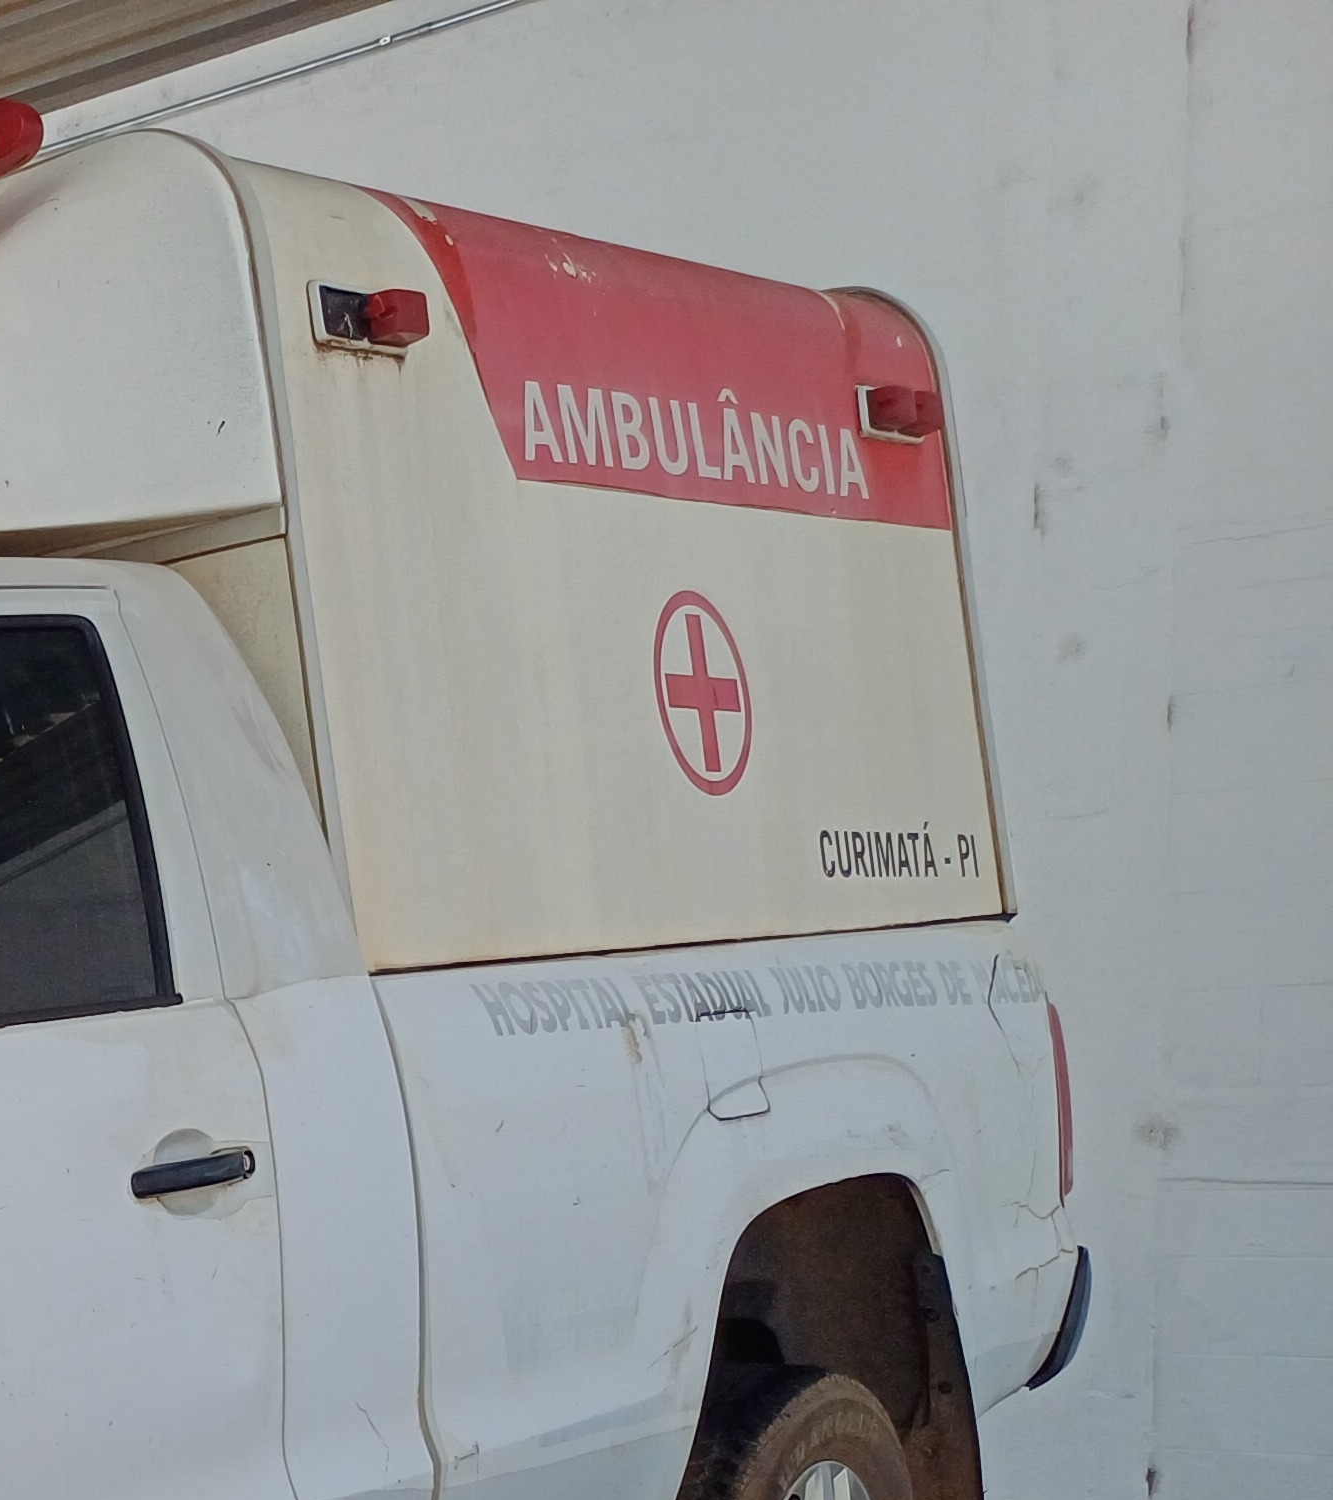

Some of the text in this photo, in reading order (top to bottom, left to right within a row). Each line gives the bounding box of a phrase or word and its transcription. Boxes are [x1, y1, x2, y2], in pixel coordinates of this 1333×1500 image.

[523, 380, 870, 500] AMBULÂNCIA
[819, 821, 939, 879] CURIMATÁ
[956, 833, 980, 879] PI
[468, 976, 636, 1037] HOSPITAL
[631, 968, 772, 1025] ESTADUAL
[767, 955, 842, 1015] JÚLIO
[840, 959, 938, 1010] BORGES
[935, 959, 974, 1006] DE
